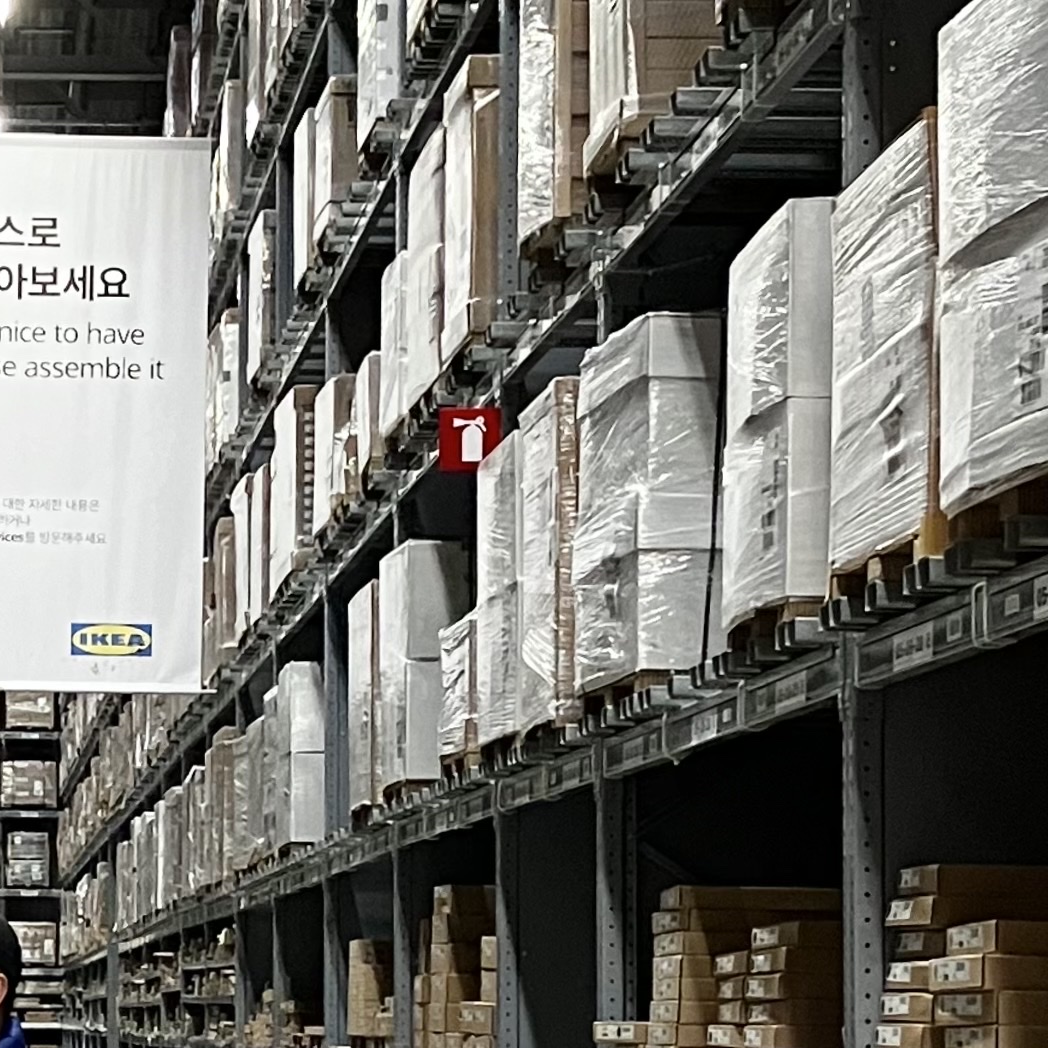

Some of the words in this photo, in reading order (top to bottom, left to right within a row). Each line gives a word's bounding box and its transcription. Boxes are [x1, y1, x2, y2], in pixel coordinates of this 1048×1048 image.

[55, 325, 78, 343] to
[87, 321, 144, 345] have
[24, 356, 141, 380] assemble
[150, 359, 164, 380] it
[79, 633, 145, 647] IKEA
